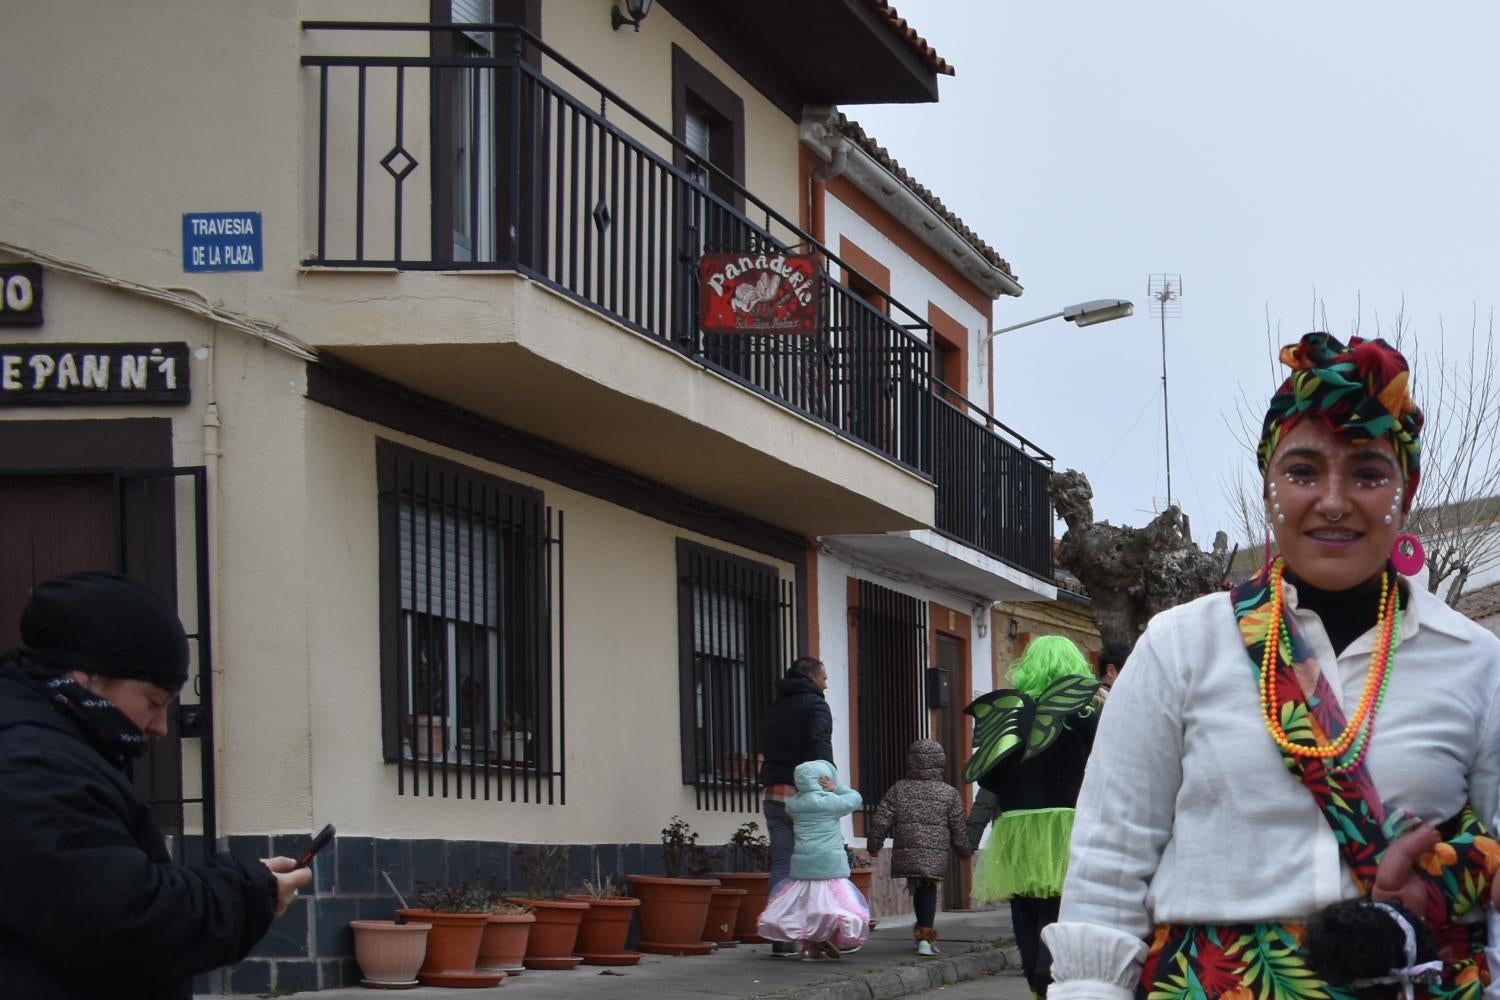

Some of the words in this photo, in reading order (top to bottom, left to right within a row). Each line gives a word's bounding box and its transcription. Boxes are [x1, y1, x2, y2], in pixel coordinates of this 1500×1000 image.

[191, 218, 254, 235] TRAVESIA
[192, 246, 206, 266] DE
[208, 246, 221, 265] LA
[224, 245, 255, 265] PLAZA
[29, 352, 110, 390] PAN
